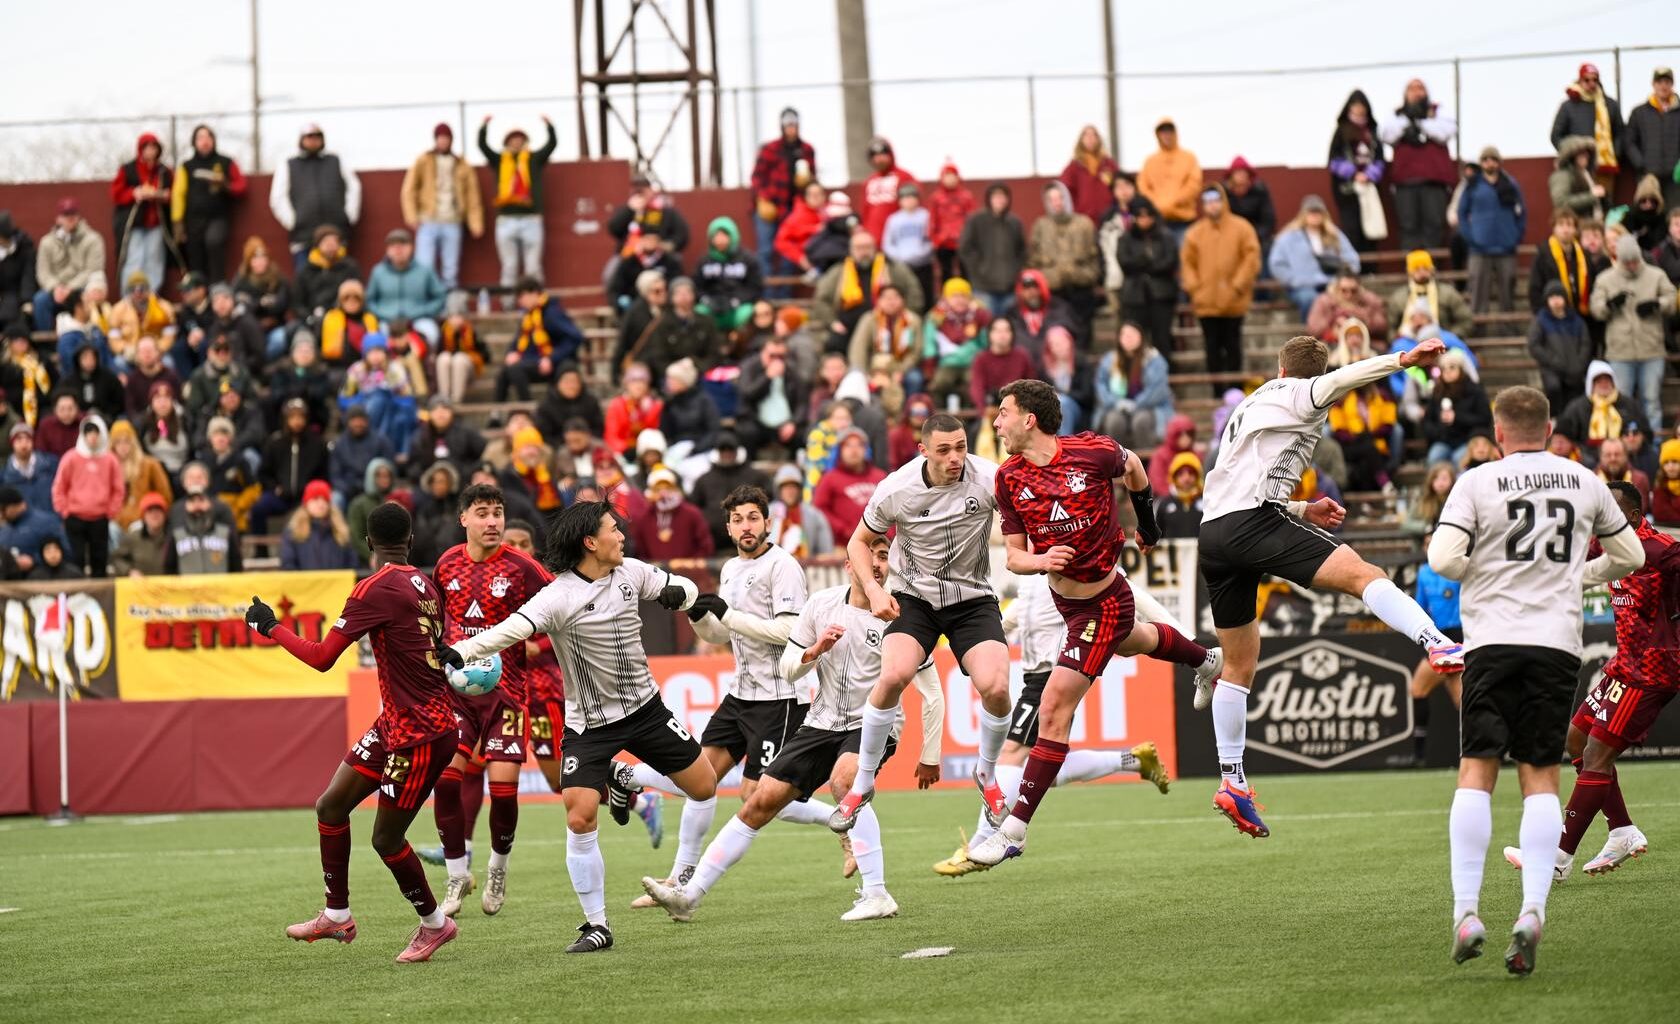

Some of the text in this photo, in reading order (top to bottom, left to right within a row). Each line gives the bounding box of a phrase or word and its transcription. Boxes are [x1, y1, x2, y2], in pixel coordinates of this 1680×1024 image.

[1497, 472, 1581, 493] McLAUGHLIN
[1505, 498, 1575, 563] 23
[1246, 670, 1398, 721] Austin
[502, 710, 525, 737] 21
[1015, 703, 1034, 728] 7
[1264, 719, 1380, 745] BROTHERS
[760, 740, 775, 767] 3
